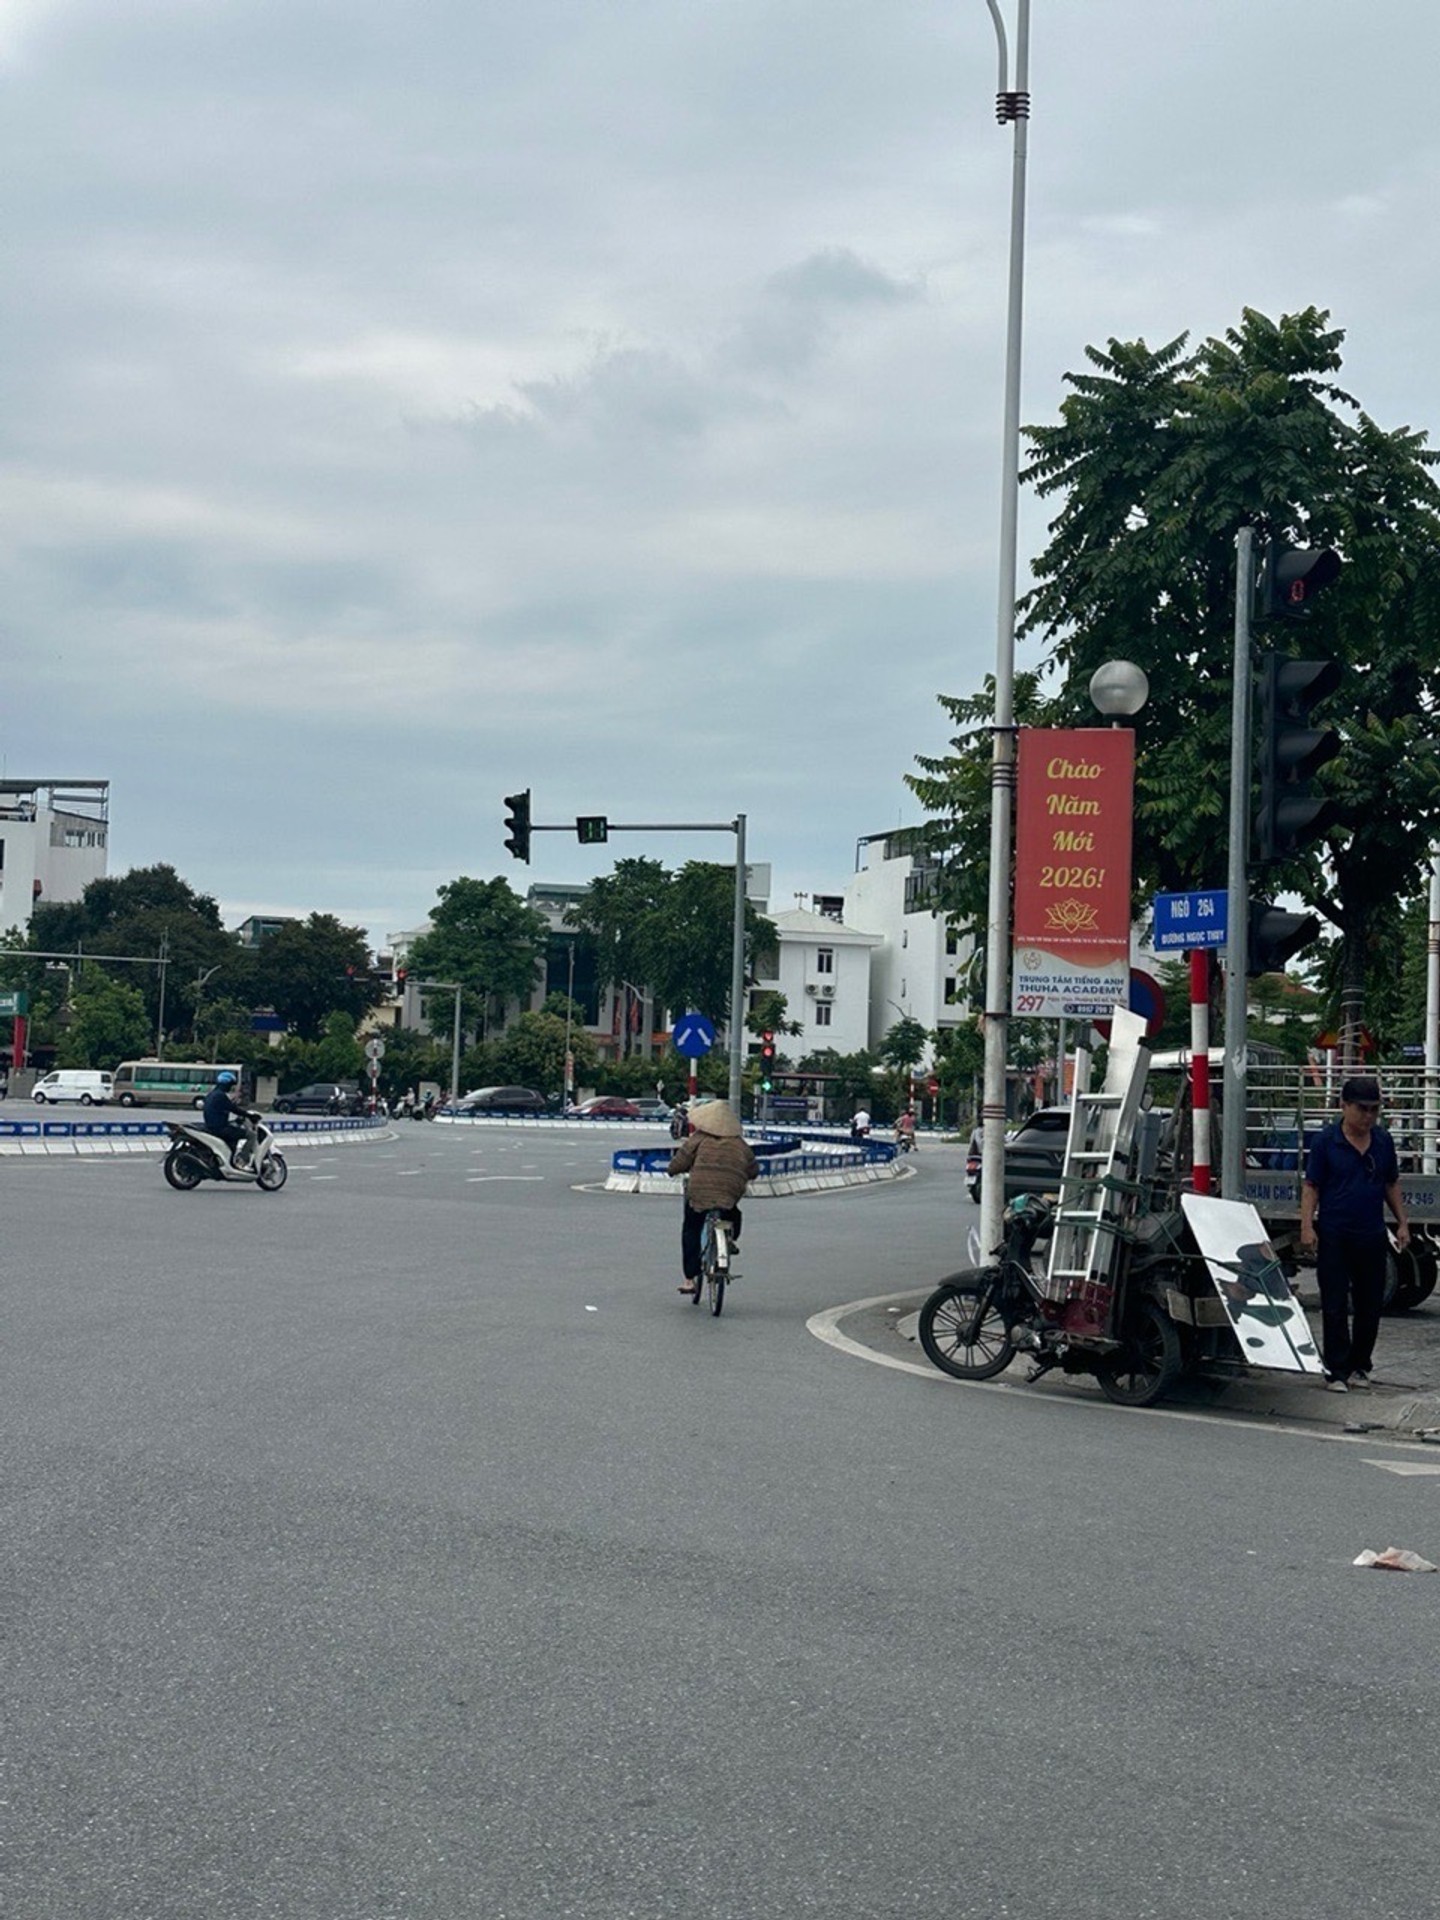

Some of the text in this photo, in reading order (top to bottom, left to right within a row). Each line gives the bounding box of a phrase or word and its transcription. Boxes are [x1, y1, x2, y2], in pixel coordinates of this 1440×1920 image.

[1047, 757, 1104, 779] Chào
[1046, 794, 1101, 815] Năm
[1053, 830, 1095, 852] Mới
[1039, 865, 1106, 888] 2026!
[1170, 895, 1215, 918] NGÕ 264
[1018, 974, 1124, 985] TRUNG TÂM TIẾNG ANH
[1019, 984, 1123, 995] THUHA ACADEMY
[1016, 994, 1045, 1012] 297
